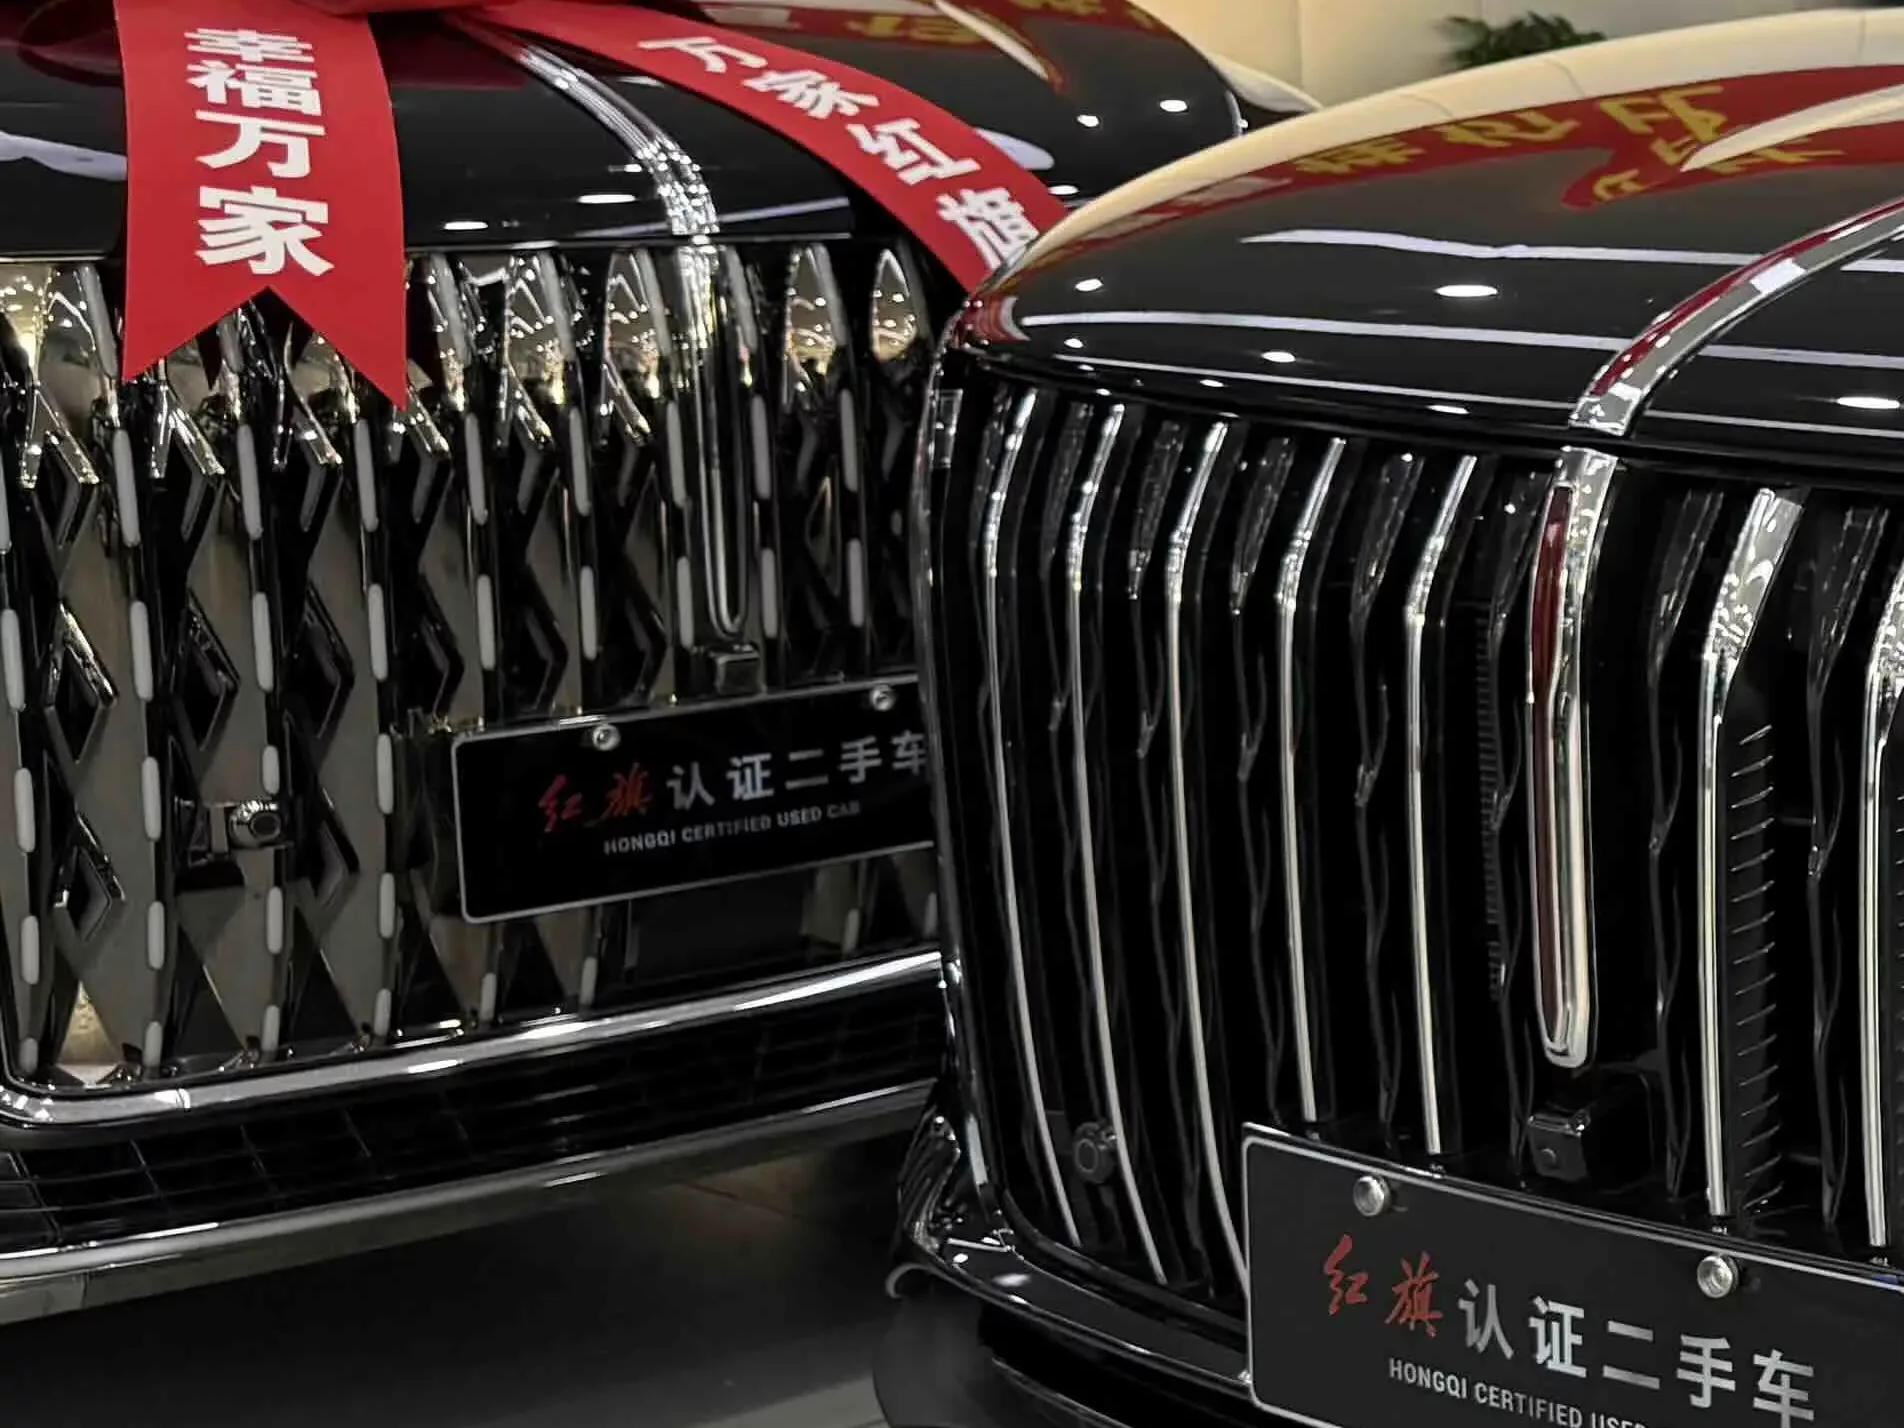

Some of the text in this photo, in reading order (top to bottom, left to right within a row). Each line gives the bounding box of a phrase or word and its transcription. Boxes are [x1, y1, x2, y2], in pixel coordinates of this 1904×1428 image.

[184, 27, 335, 278] 幸福万家
[638, 36, 1044, 271] 万家红旗
[604, 829, 676, 855] HONGQI
[681, 814, 771, 843] CERTIFIED
[777, 806, 822, 828] USED
[1389, 1358, 1468, 1400] HONGQI
